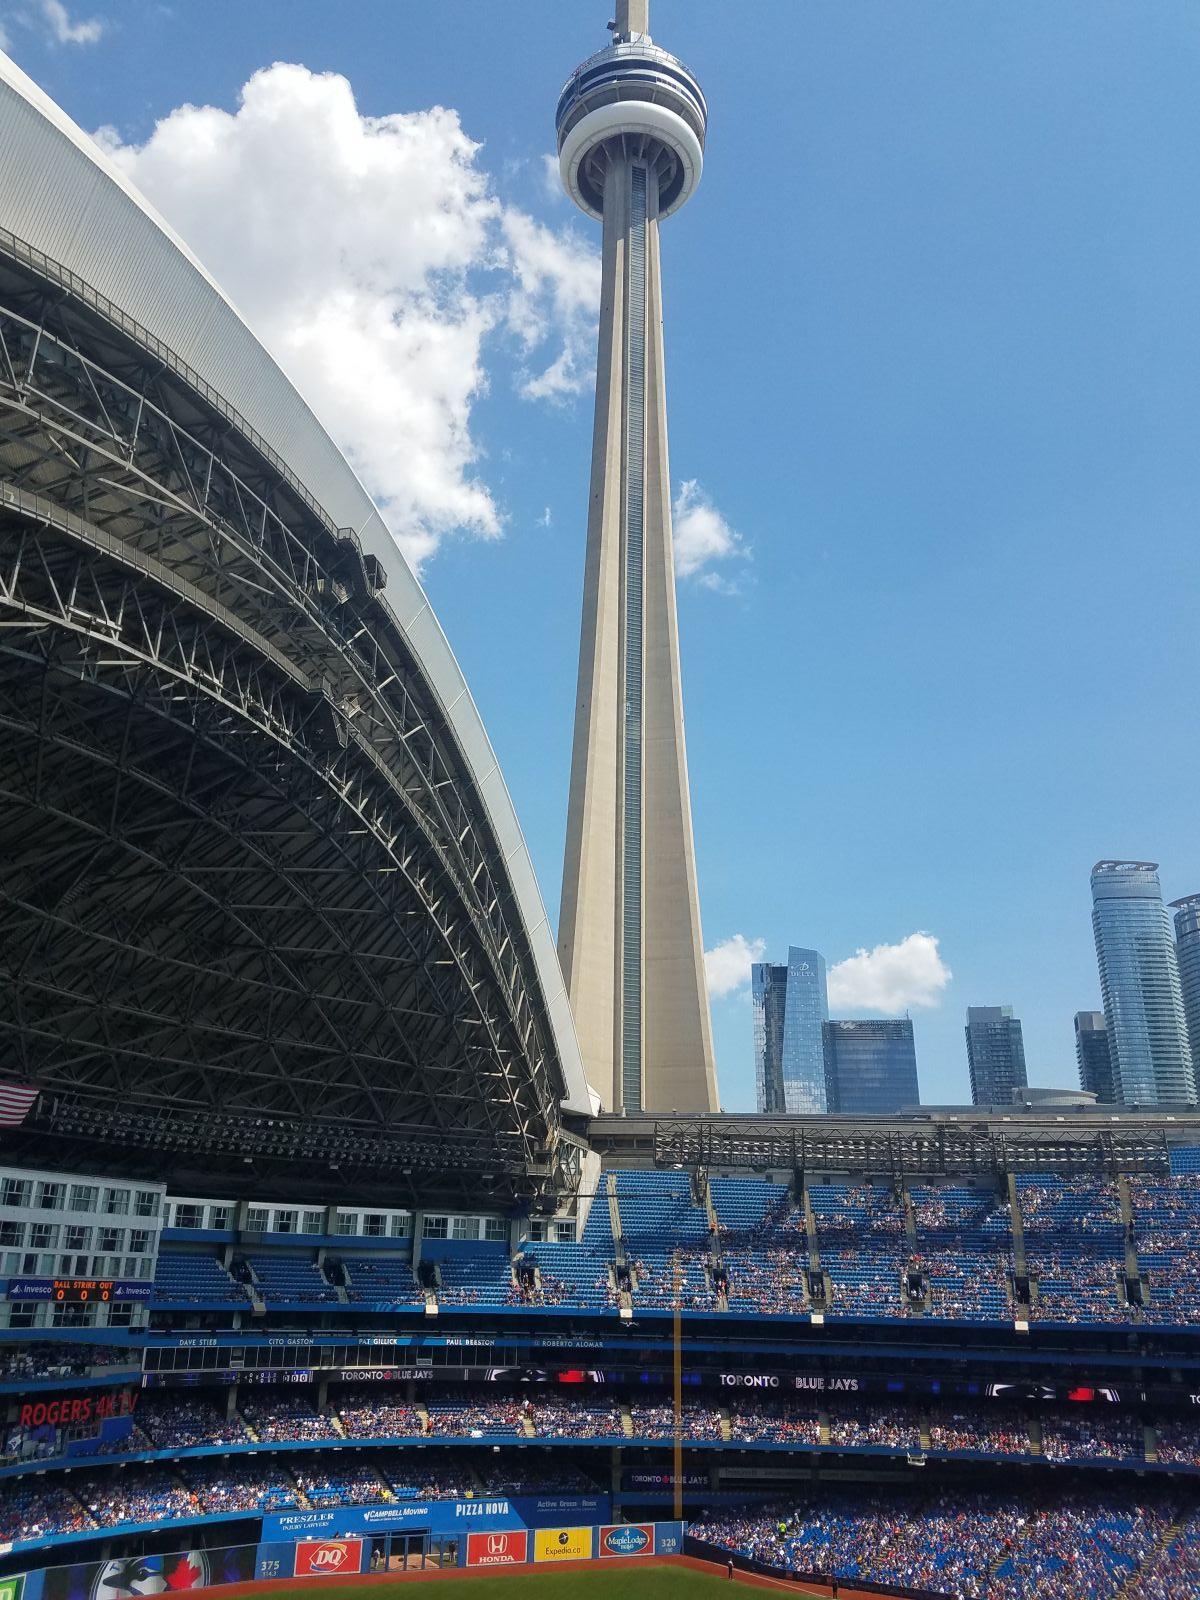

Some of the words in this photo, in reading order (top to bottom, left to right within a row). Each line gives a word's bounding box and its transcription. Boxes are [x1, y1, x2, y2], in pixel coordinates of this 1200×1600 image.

[24, 1285, 52, 1294] Invesco
[53, 1281, 70, 1289] BALL
[73, 1281, 96, 1289] STRIKE
[99, 1282, 114, 1290] OUT
[125, 1286, 151, 1295] Invesco
[57, 1290, 64, 1300] 0
[80, 1290, 88, 1301] 0
[102, 1291, 109, 1301] 0
[341, 1371, 383, 1381] TORONTO
[393, 1371, 411, 1380] BLUE
[412, 1370, 433, 1379] JAYS
[719, 1374, 780, 1388] TORONTO
[795, 1376, 825, 1390] BLUE
[828, 1377, 859, 1391] JAYS
[20, 1398, 92, 1426] ROGERS
[631, 1475, 661, 1483] TORONTO
[669, 1475, 686, 1484] BLUE
[688, 1475, 708, 1484] JAYS
[370, 1509, 402, 1518] CAMPBELL
[402, 1507, 429, 1516] MOVING
[456, 1503, 483, 1517] PIZZA
[485, 1502, 509, 1515] NOVA
[279, 1513, 335, 1525] PRESZLER
[303, 1521, 330, 1529] LAWYERS
[661, 1538, 677, 1547] 328
[545, 1546, 581, 1556] Expedia.ca
[316, 1550, 342, 1566] DQ
[479, 1555, 514, 1564] HONDA
[261, 1560, 280, 1571] 375
